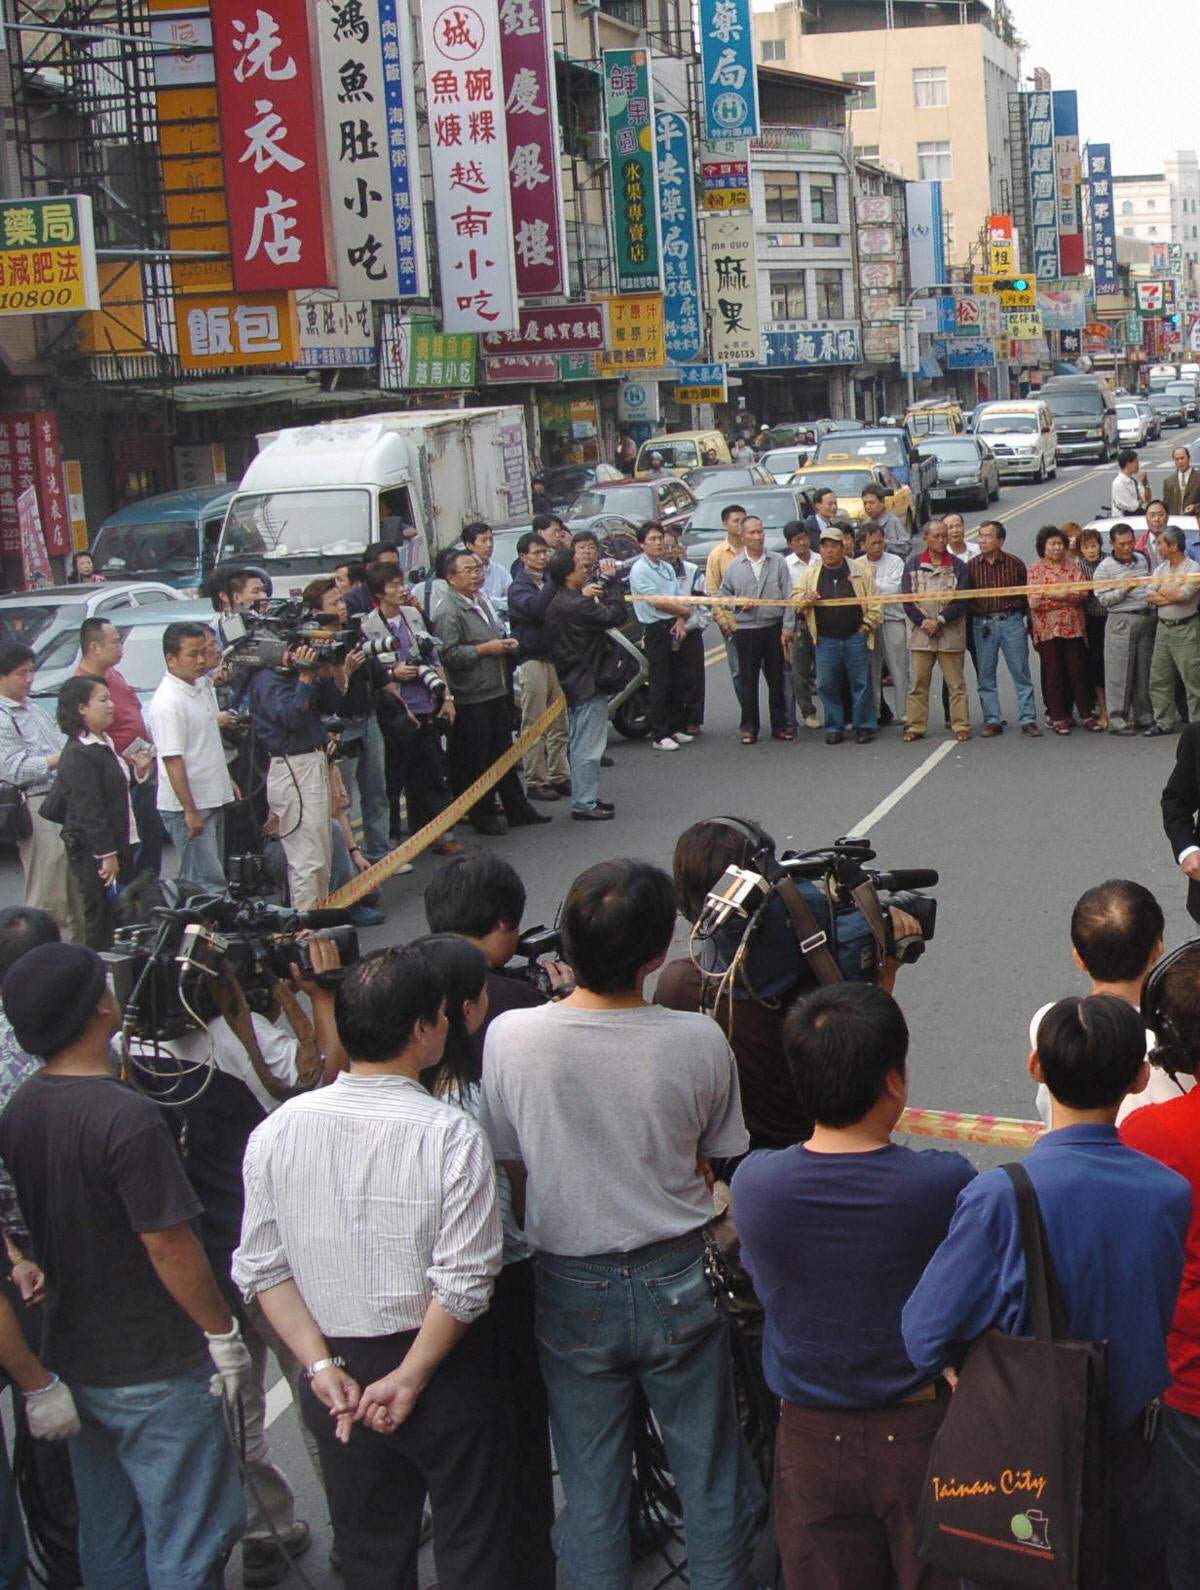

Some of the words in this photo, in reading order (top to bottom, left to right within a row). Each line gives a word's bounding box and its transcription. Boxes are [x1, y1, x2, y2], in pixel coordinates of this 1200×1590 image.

[709, 0, 747, 90] 藥局
[232, 9, 305, 265] 洗衣店
[3, 204, 75, 246] 藥局
[449, 160, 500, 322] 越南小吃
[0, 251, 79, 286] 減肥法
[186, 305, 281, 357] 飯包
[932, 1477, 996, 1500] Tainan
[1000, 1470, 1048, 1499] City
